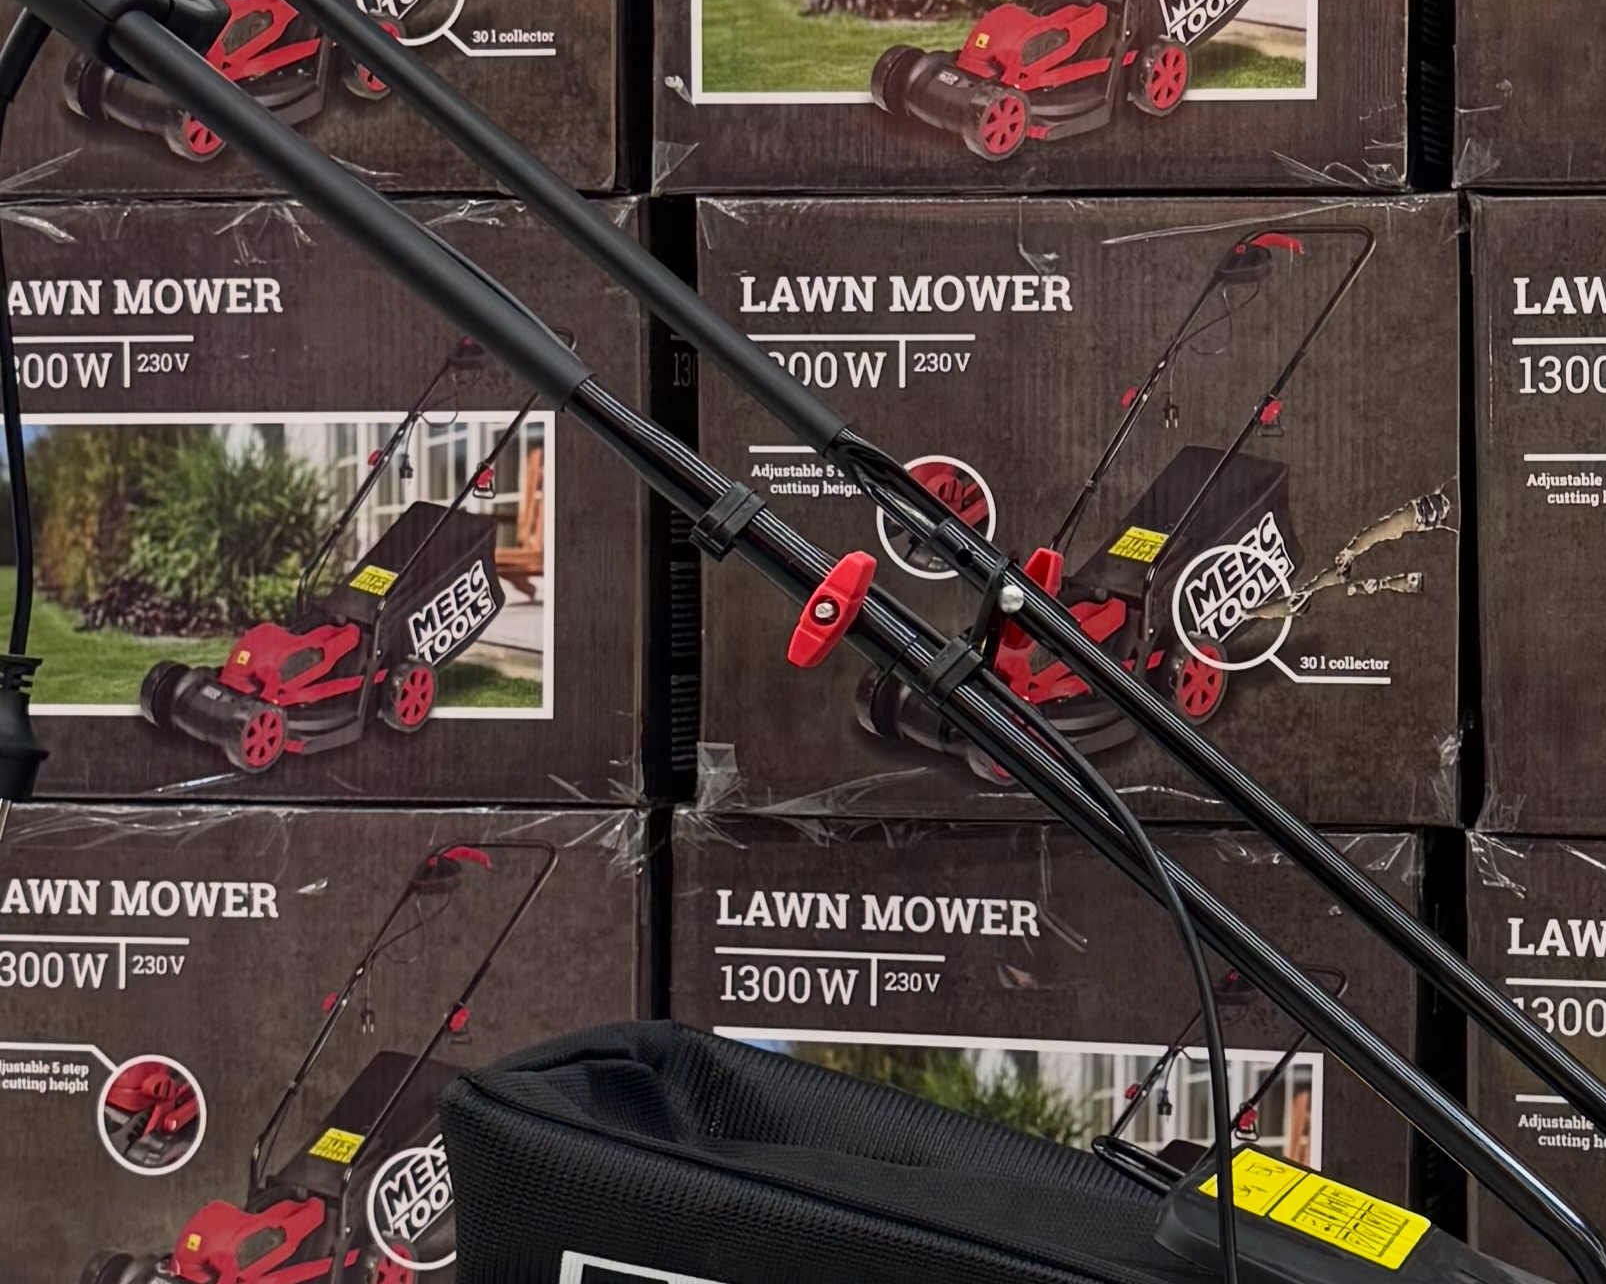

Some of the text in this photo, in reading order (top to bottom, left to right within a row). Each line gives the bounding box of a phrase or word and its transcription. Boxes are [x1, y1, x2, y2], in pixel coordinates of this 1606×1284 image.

[472, 30, 489, 44] 30
[498, 28, 555, 43] collector
[7, 277, 284, 316] AWN MOWER
[739, 275, 1073, 313] LAWN MOWER
[750, 463, 824, 481] Adjustable
[826, 464, 835, 478] 5
[1526, 472, 1603, 490] Adjustable
[769, 480, 862, 498] cutting heig
[1547, 490, 1600, 507] cutting
[409, 561, 485, 646] MEEC
[419, 591, 495, 662] TOOLS
[1299, 656, 1318, 670] 30
[1328, 656, 1390, 670] collector
[0, 878, 279, 918] AWN MOWER
[716, 889, 1040, 937] LAWN MOWER
[0, 1059, 90, 1078] justable 5 step
[1, 1076, 89, 1094] cutting height
[1517, 1113, 1594, 1132] Adjustable
[1537, 1132, 1591, 1151] cutting
